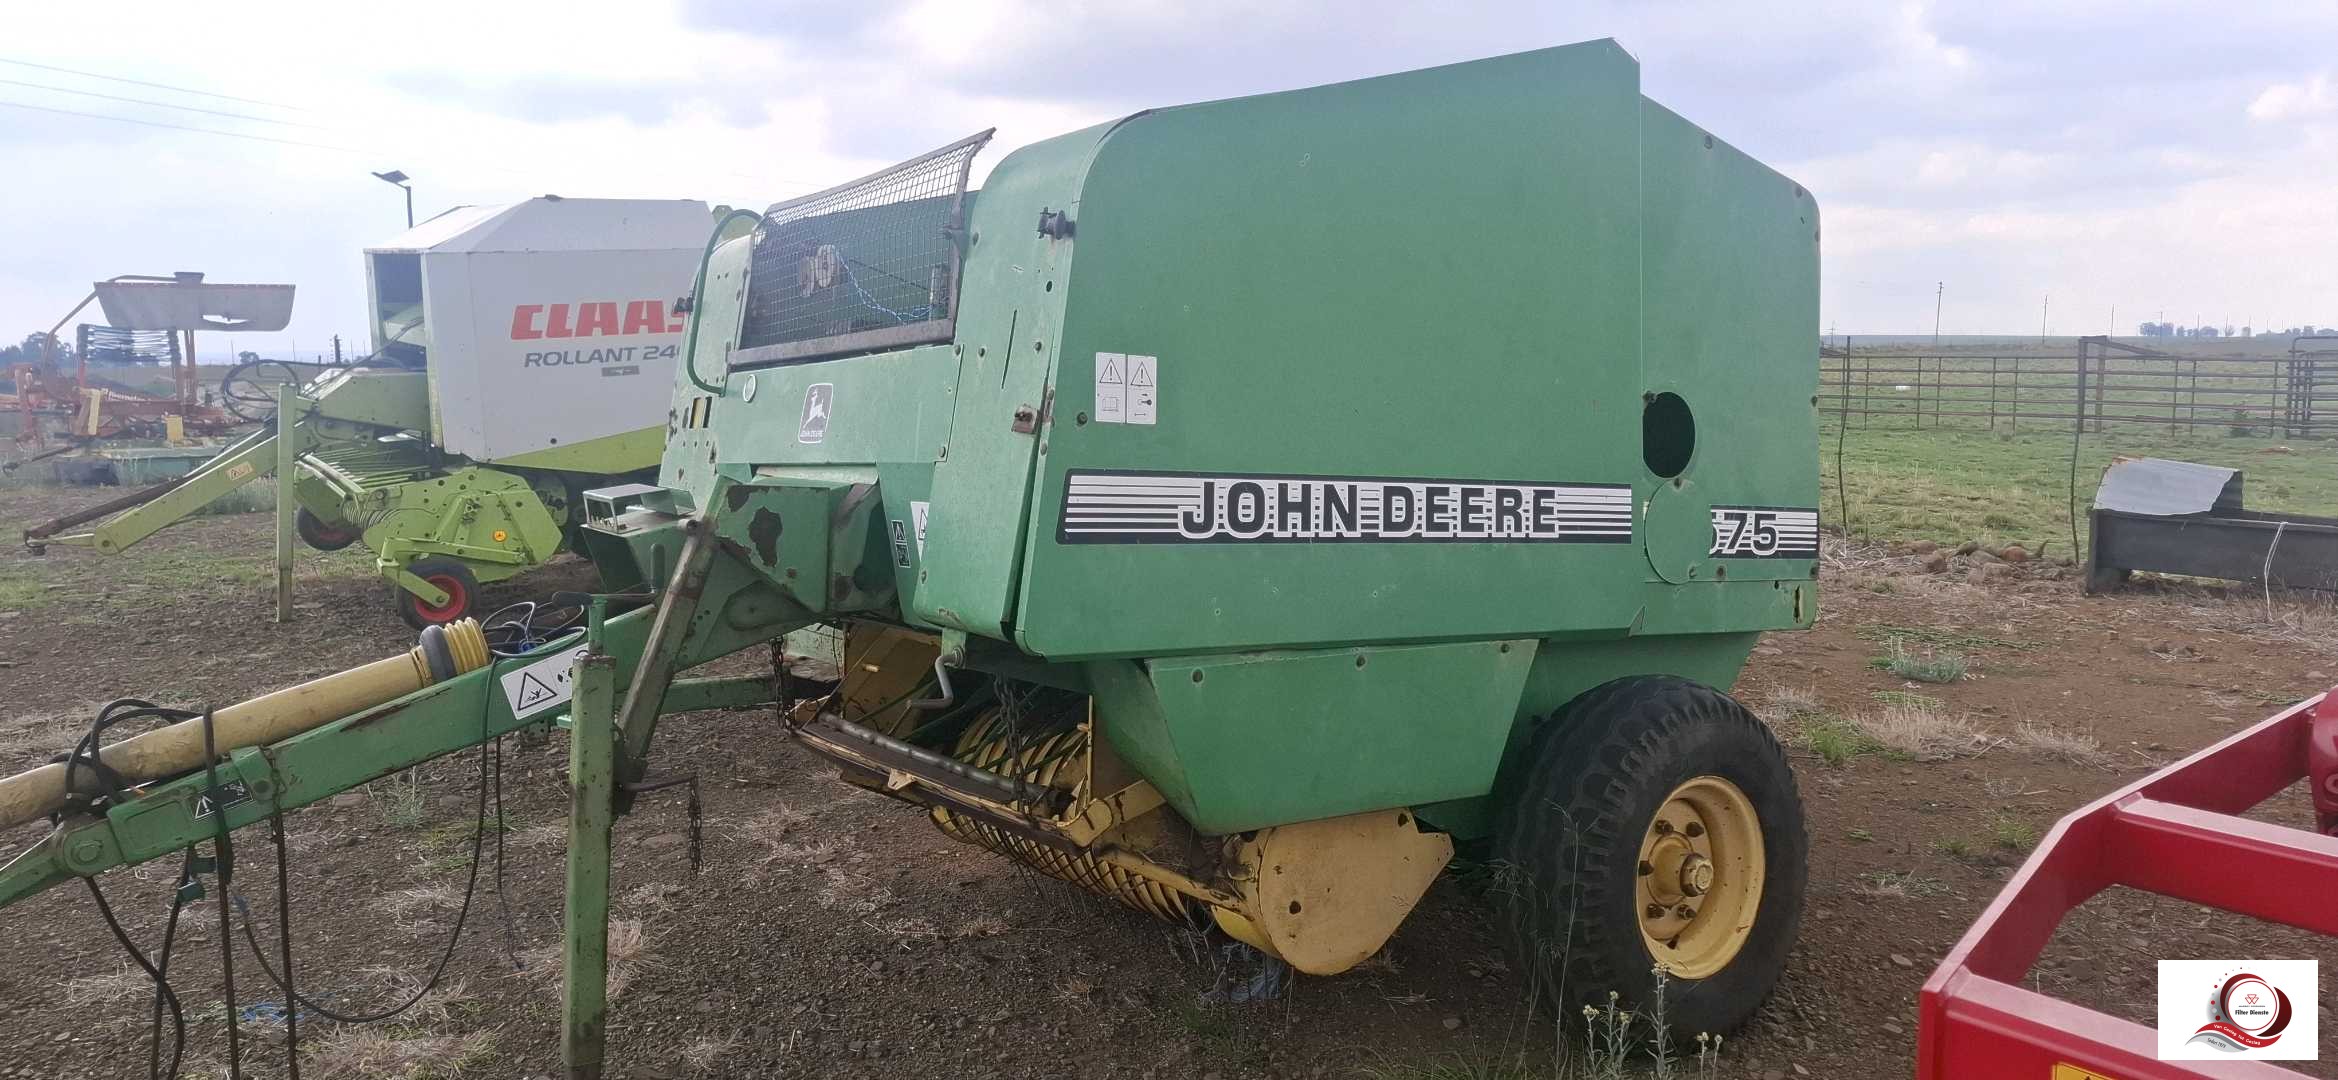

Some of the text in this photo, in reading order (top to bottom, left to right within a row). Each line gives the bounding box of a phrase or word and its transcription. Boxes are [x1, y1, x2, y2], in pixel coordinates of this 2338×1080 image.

[524, 344, 680, 368] ROLLANT 24
[1179, 480, 1559, 538] JOHN DEERE
[1710, 511, 1779, 555] 75
